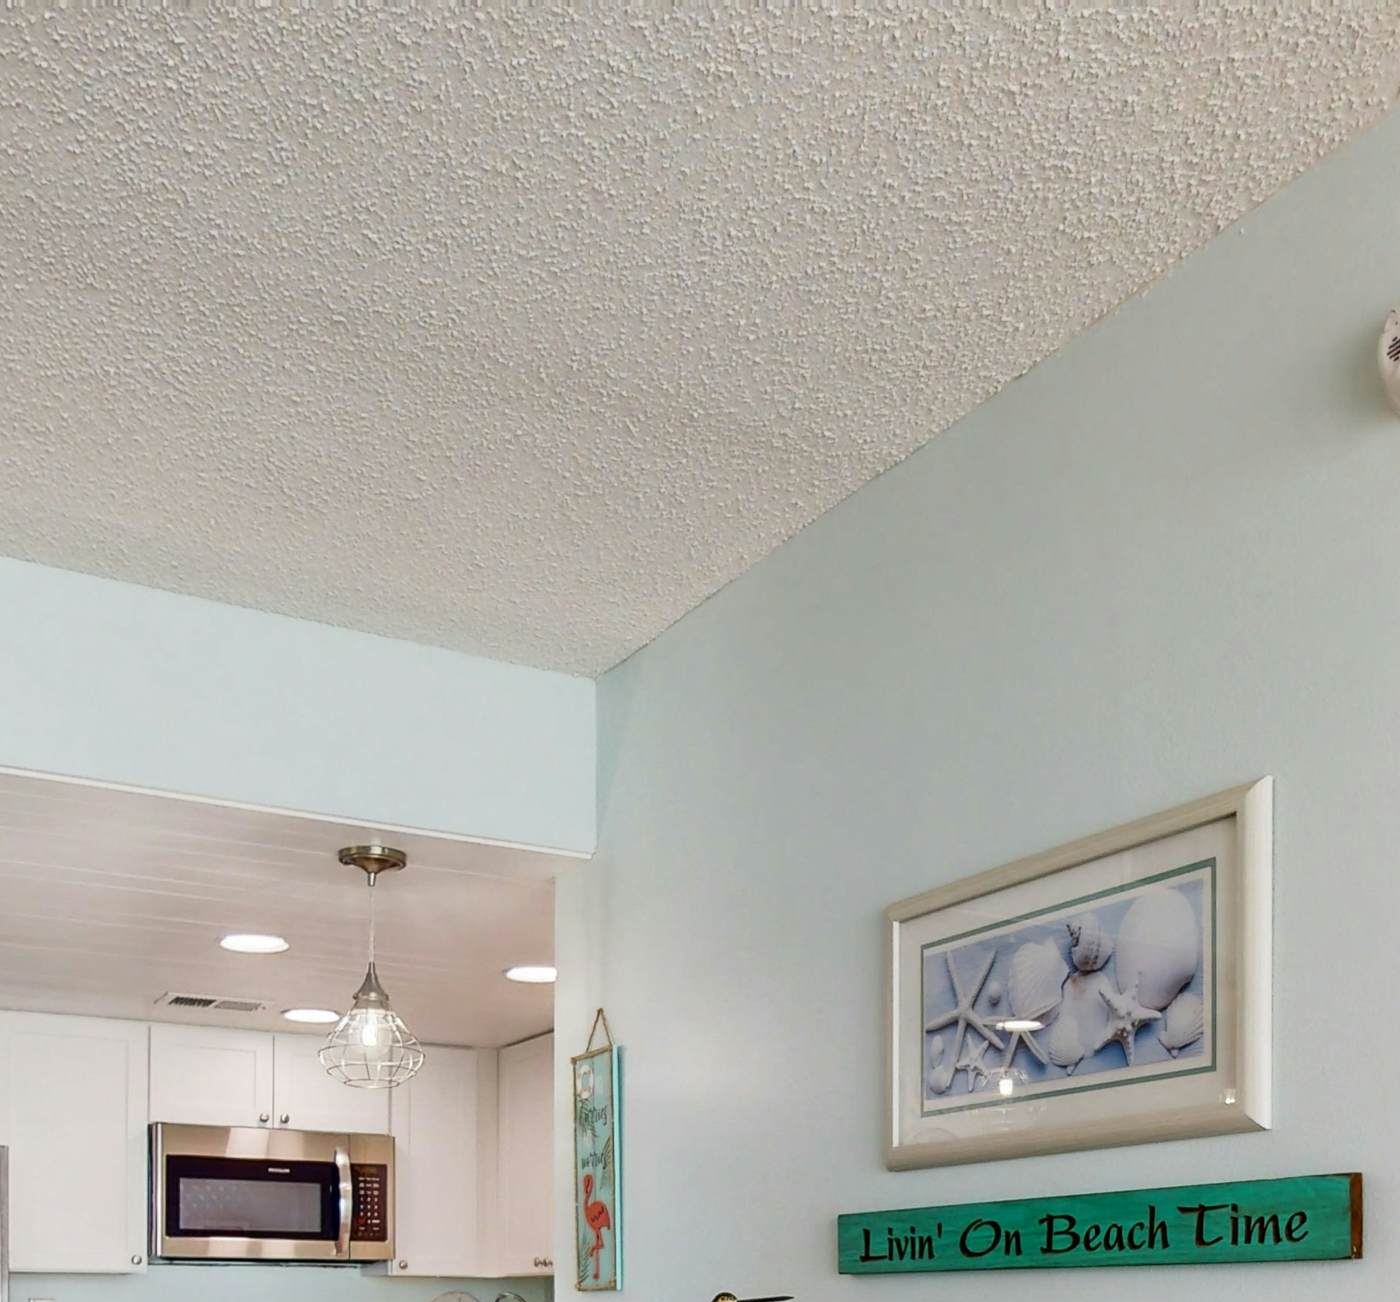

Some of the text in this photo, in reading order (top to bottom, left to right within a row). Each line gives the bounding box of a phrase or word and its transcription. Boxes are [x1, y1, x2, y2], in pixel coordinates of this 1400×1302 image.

[860, 1203, 1309, 1263] Livin' On Beach Time
